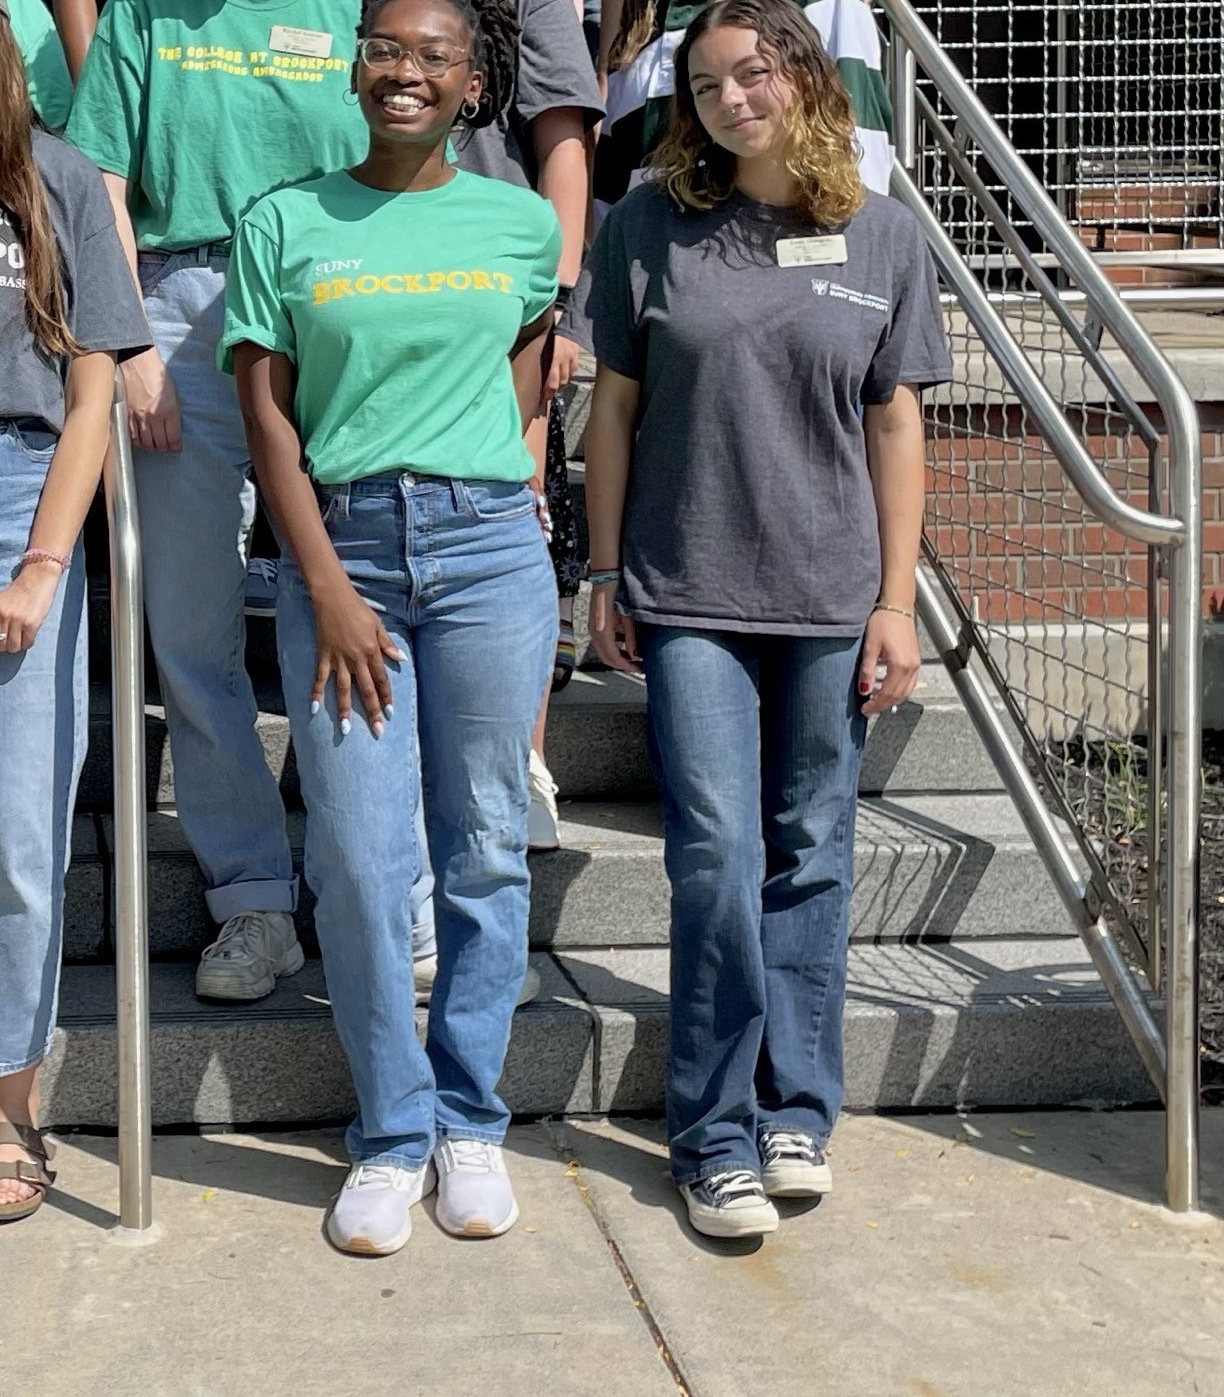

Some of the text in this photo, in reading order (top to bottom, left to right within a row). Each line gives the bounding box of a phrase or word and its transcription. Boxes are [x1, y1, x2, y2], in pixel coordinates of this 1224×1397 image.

[158, 46, 182, 61] THE
[273, 56, 349, 72] BROCKPORT
[315, 258, 364, 277] SUNY
[312, 269, 514, 306] BROCKPORT
